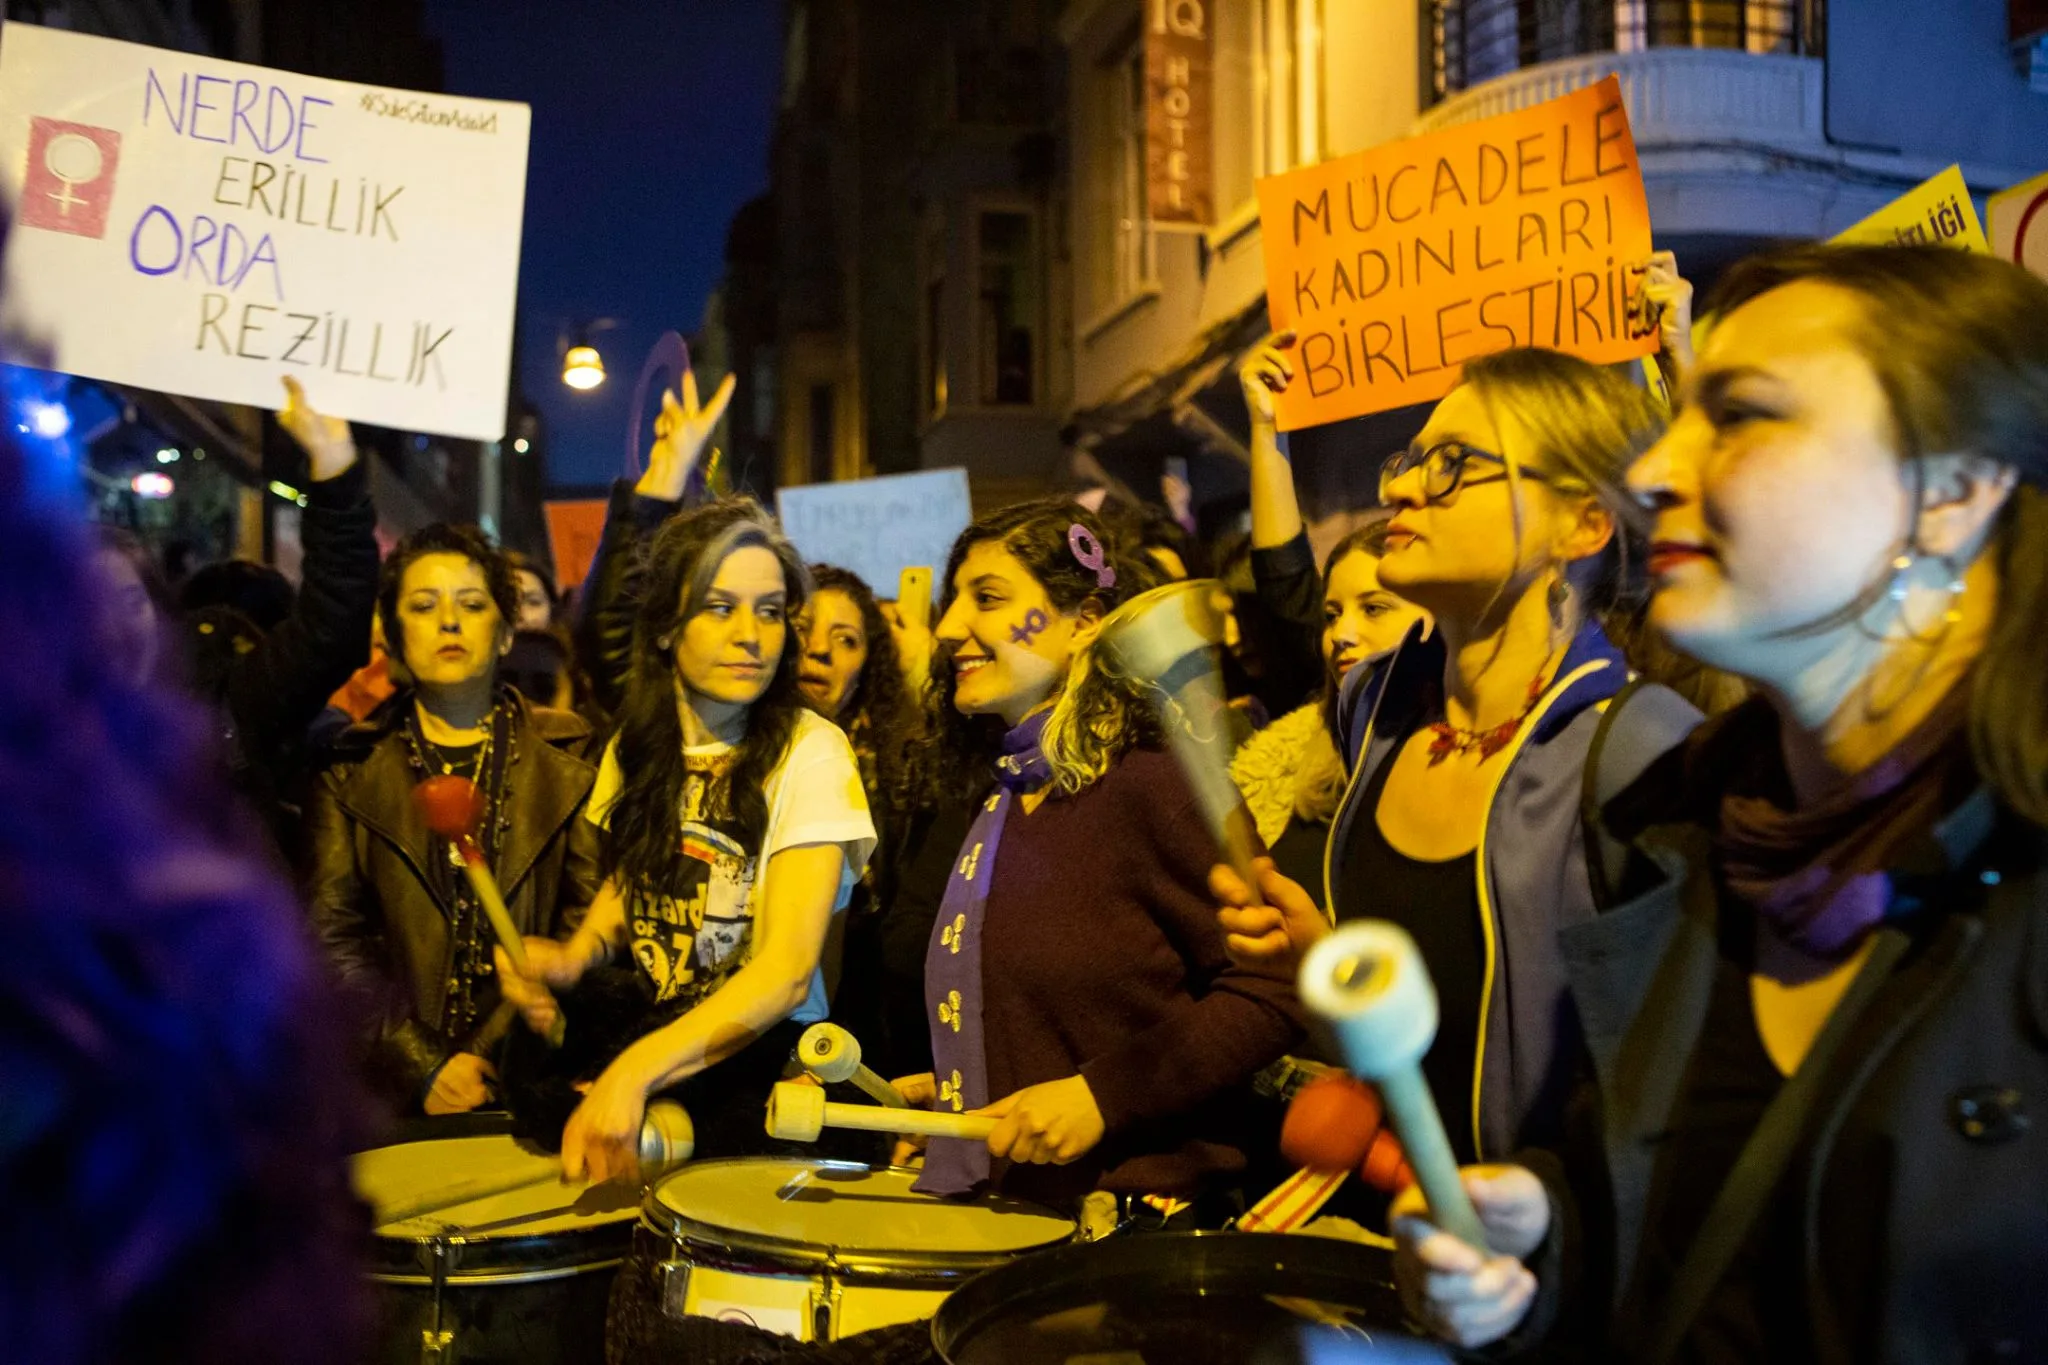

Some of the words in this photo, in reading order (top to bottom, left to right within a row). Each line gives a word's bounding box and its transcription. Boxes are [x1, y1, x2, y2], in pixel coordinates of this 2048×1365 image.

[143, 67, 334, 163] NERDE
[214, 155, 405, 242] ERİLLİK
[1293, 103, 1628, 246] MÜCADELE
[130, 204, 284, 302] ORDA
[1293, 195, 1613, 316] KADINLARI
[633, 883, 707, 932] izard
